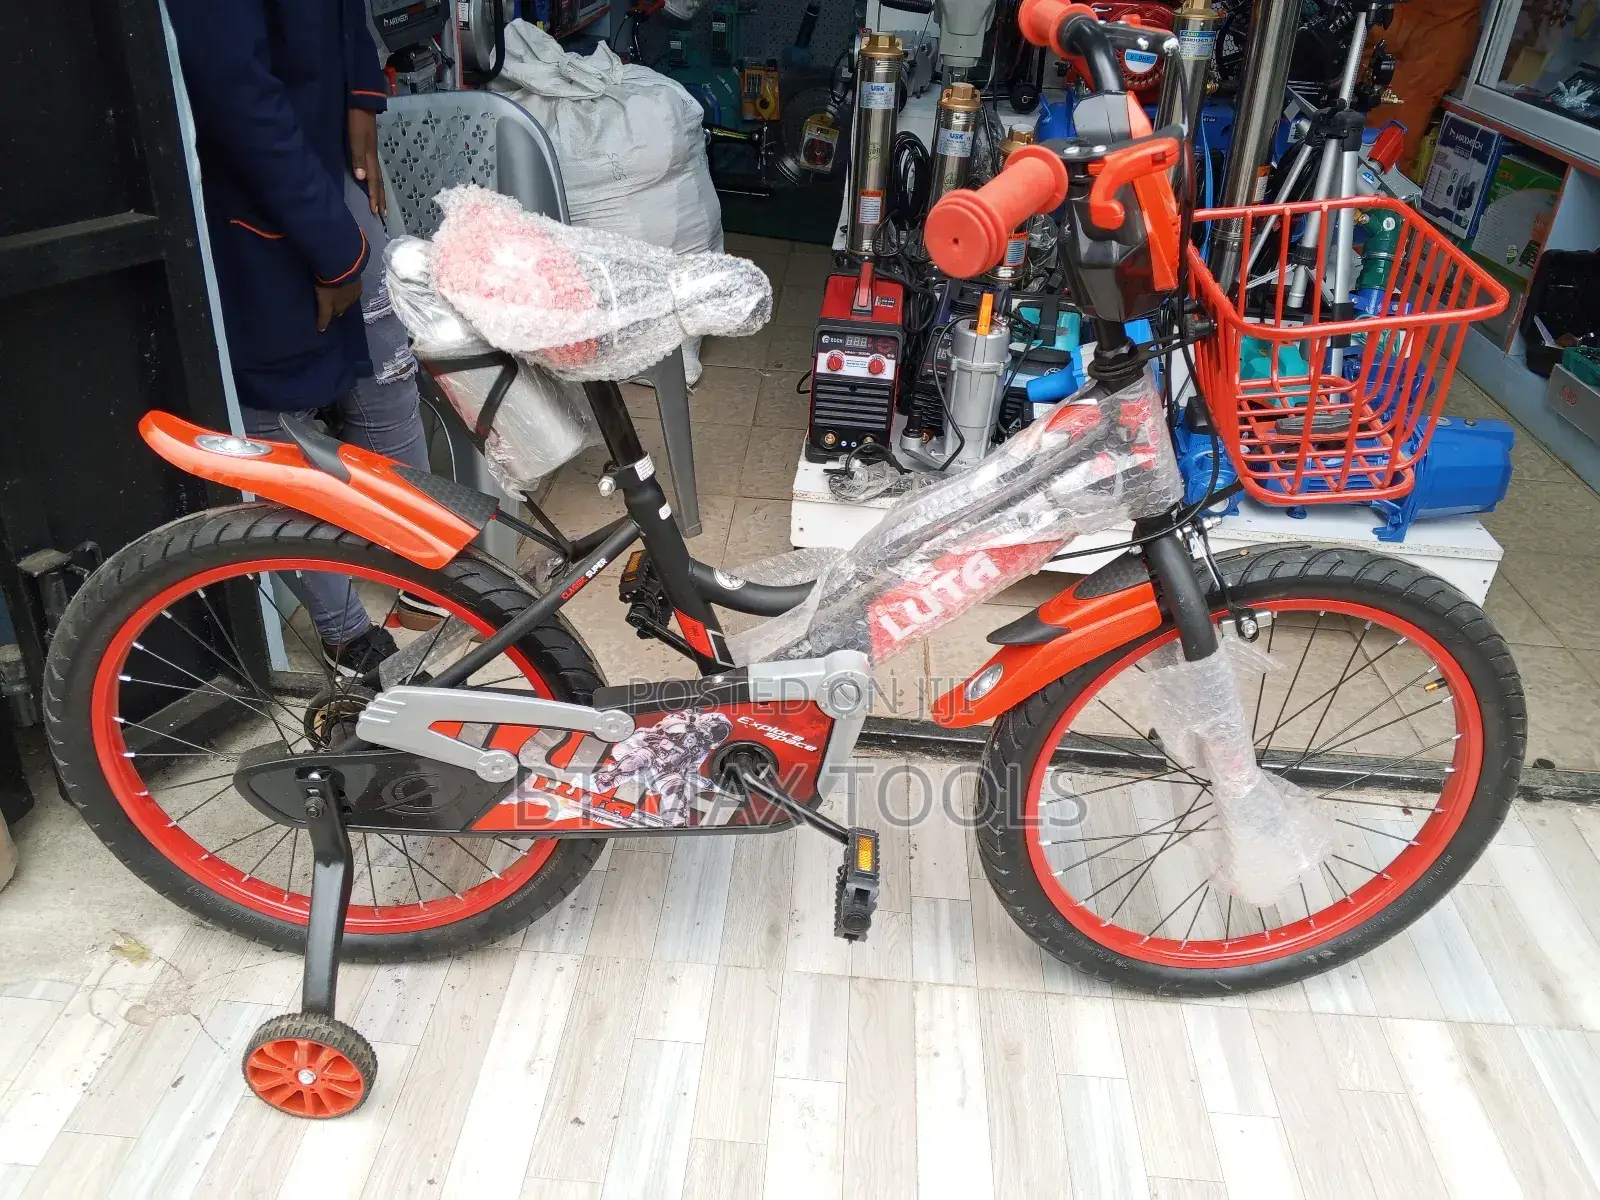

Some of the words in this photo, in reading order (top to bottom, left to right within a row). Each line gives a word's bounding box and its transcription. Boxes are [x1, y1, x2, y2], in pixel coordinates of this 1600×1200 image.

[870, 84, 885, 92] USK
[949, 132, 965, 140] USK
[585, 557, 608, 579] SUPER
[737, 716, 806, 742] Explore
[763, 731, 818, 752] space
